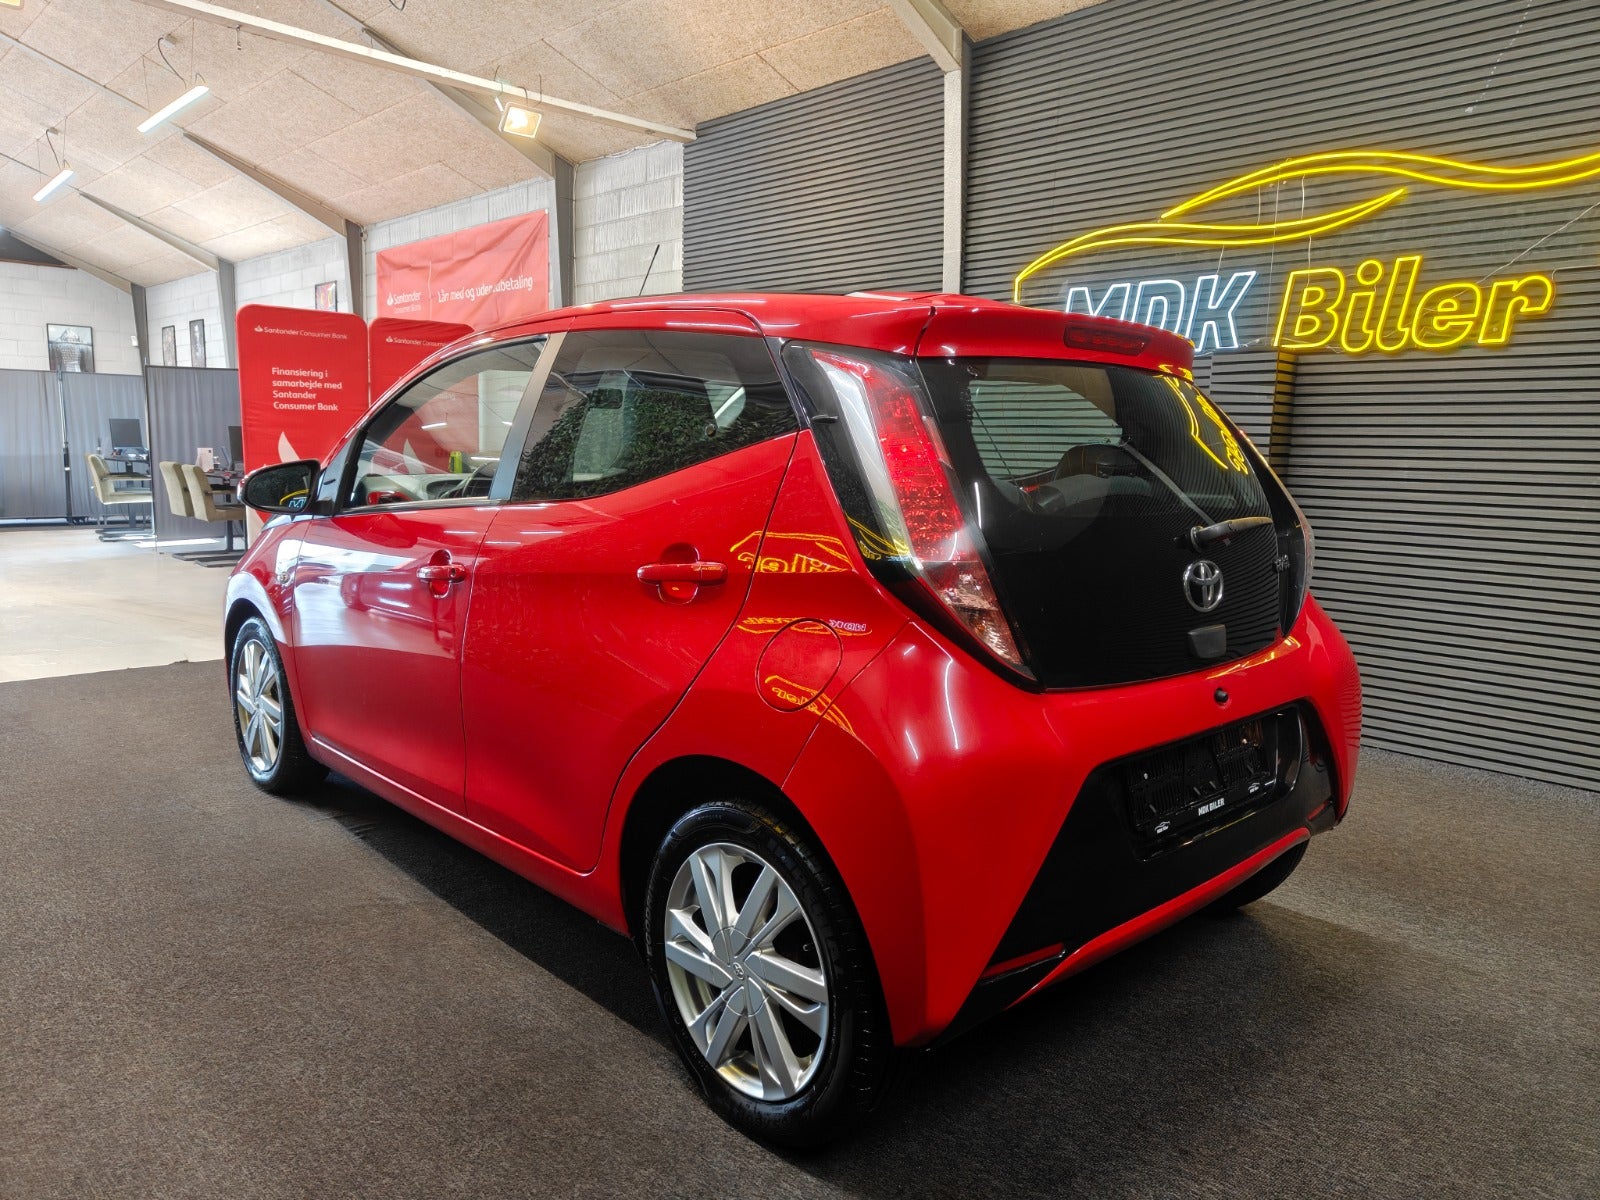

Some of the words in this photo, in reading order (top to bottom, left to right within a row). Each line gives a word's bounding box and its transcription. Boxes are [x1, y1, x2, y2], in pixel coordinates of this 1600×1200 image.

[438, 289, 449, 303] Lån
[450, 288, 464, 300] med
[465, 287, 475, 302] og
[493, 275, 533, 293] dbetaling
[1273, 255, 1553, 352] Biler
[264, 326, 300, 336] Santander
[300, 330, 331, 339] Consumer
[332, 332, 348, 340] Bank
[393, 336, 422, 346] Santander
[271, 367, 324, 379] Finansiering
[272, 380, 323, 390] samarbejde
[324, 381, 342, 390] med
[273, 390, 316, 400] Santander
[273, 401, 316, 411] Consumer
[317, 402, 338, 412] Bank
